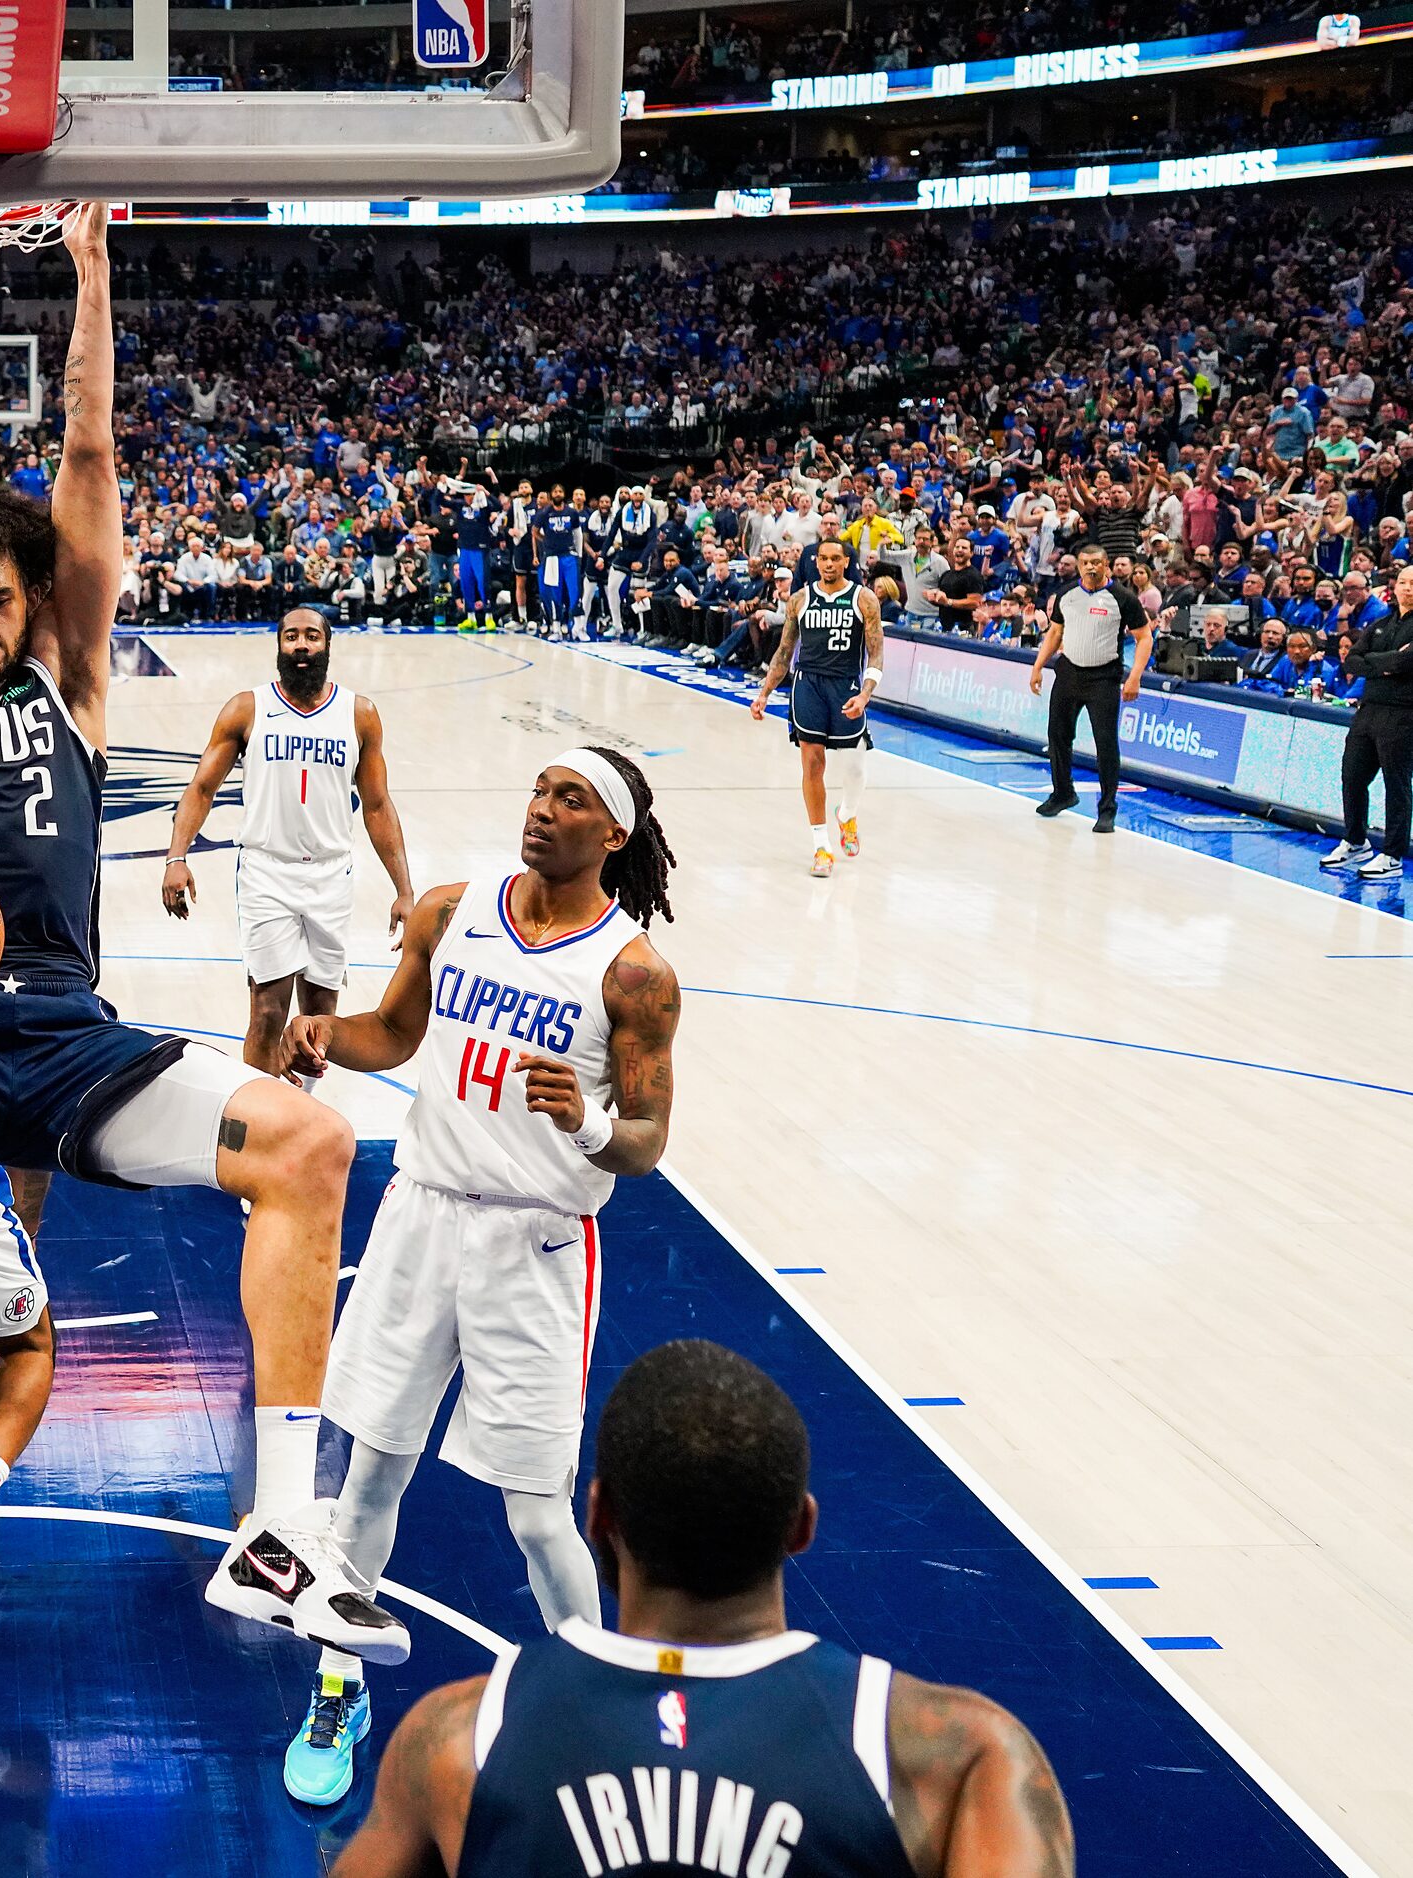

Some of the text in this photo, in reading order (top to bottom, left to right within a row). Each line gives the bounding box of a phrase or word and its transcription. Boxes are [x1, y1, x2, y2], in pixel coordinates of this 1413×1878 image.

[425, 28, 461, 56] NBA
[771, 43, 1140, 110] STANDING ON BUSINESS
[917, 149, 1278, 209] STANDING ON BUSINESS
[805, 608, 854, 629] MAVS
[828, 628, 852, 651] 25
[915, 661, 1032, 721] Hotel like a pro
[264, 733, 347, 768] CLIPPERS
[21, 766, 59, 836] 2
[300, 769, 308, 804] 1
[435, 963, 583, 1055] CLIPPERS
[456, 1036, 511, 1113] 14
[556, 1766, 804, 1878] IRVING
